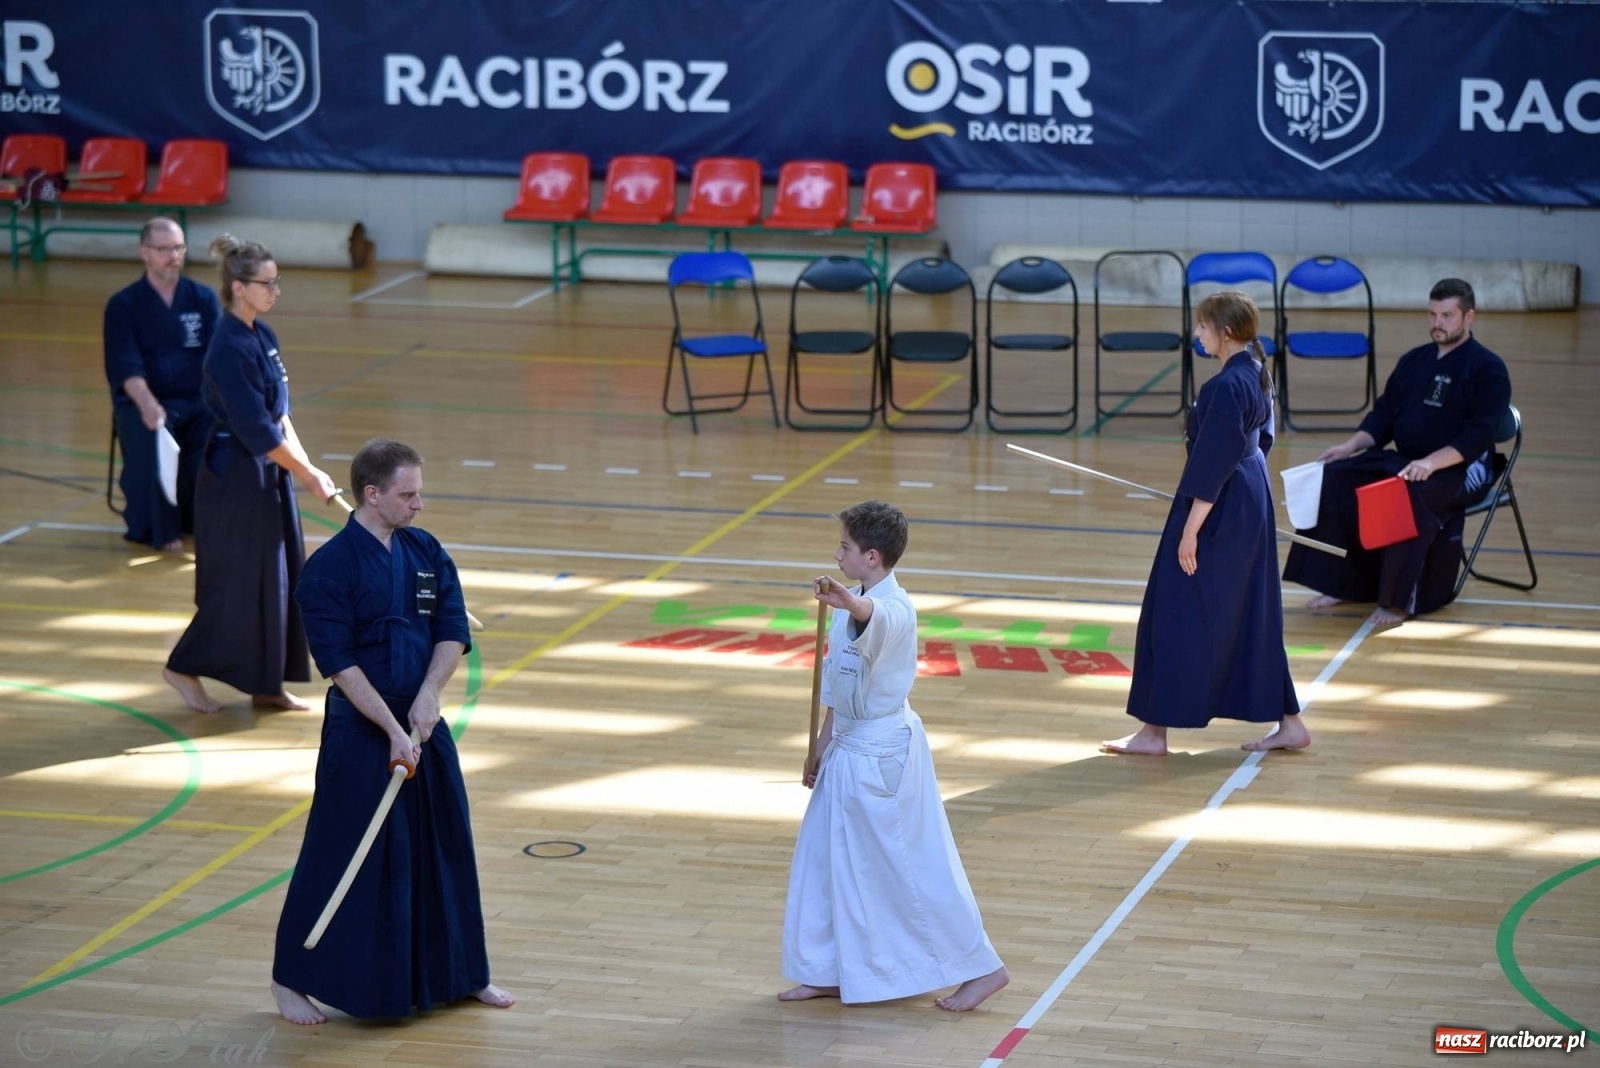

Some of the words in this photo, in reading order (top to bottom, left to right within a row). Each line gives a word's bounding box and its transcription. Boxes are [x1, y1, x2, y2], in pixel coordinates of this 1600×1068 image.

[384, 40, 731, 113] RACIBÓRZ
[0, 87, 61, 115] BÓRZ
[1459, 77, 1600, 134] RAC
[967, 118, 1094, 145] RACIBÓRZ
